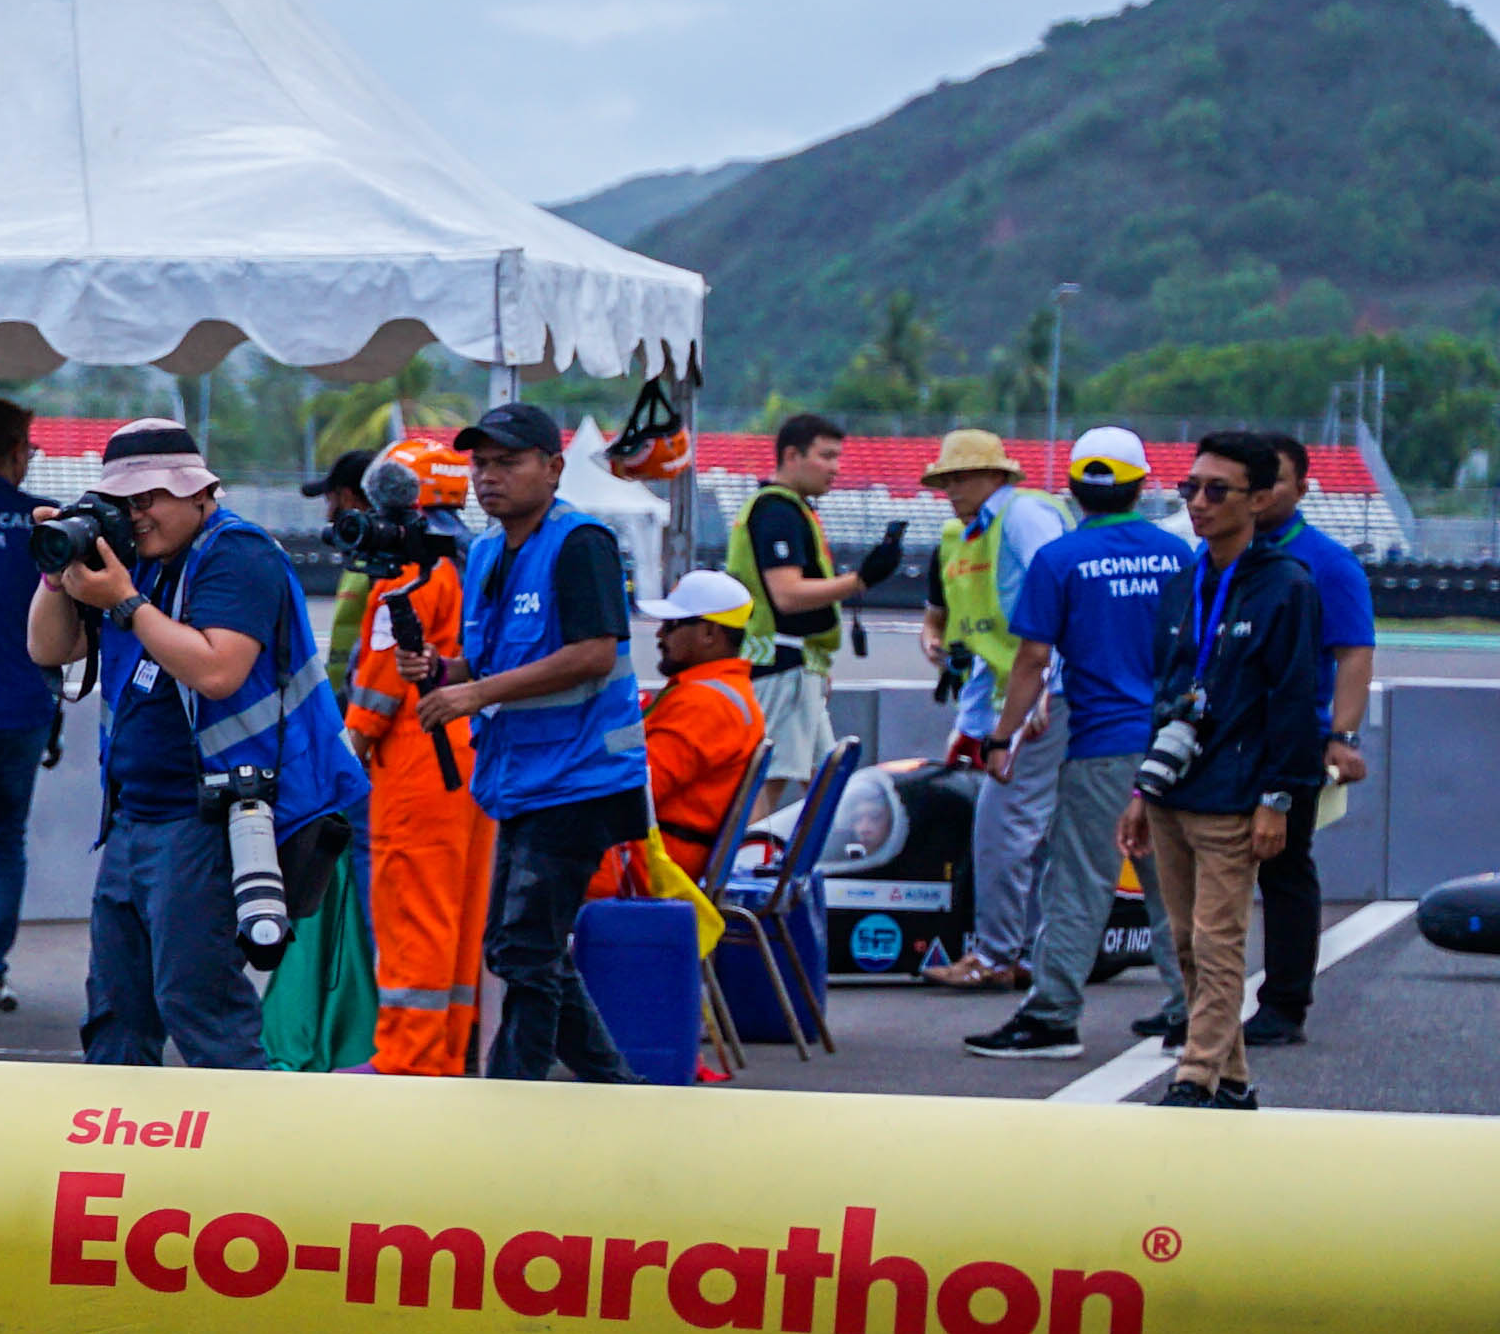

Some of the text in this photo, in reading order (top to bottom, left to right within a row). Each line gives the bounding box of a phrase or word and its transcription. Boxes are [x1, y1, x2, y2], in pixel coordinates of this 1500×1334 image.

[1078, 555, 1181, 579] TECHNICAL
[1109, 578, 1159, 597] TEAM
[1105, 928, 1124, 953] OF
[66, 1107, 210, 1149] Shell
